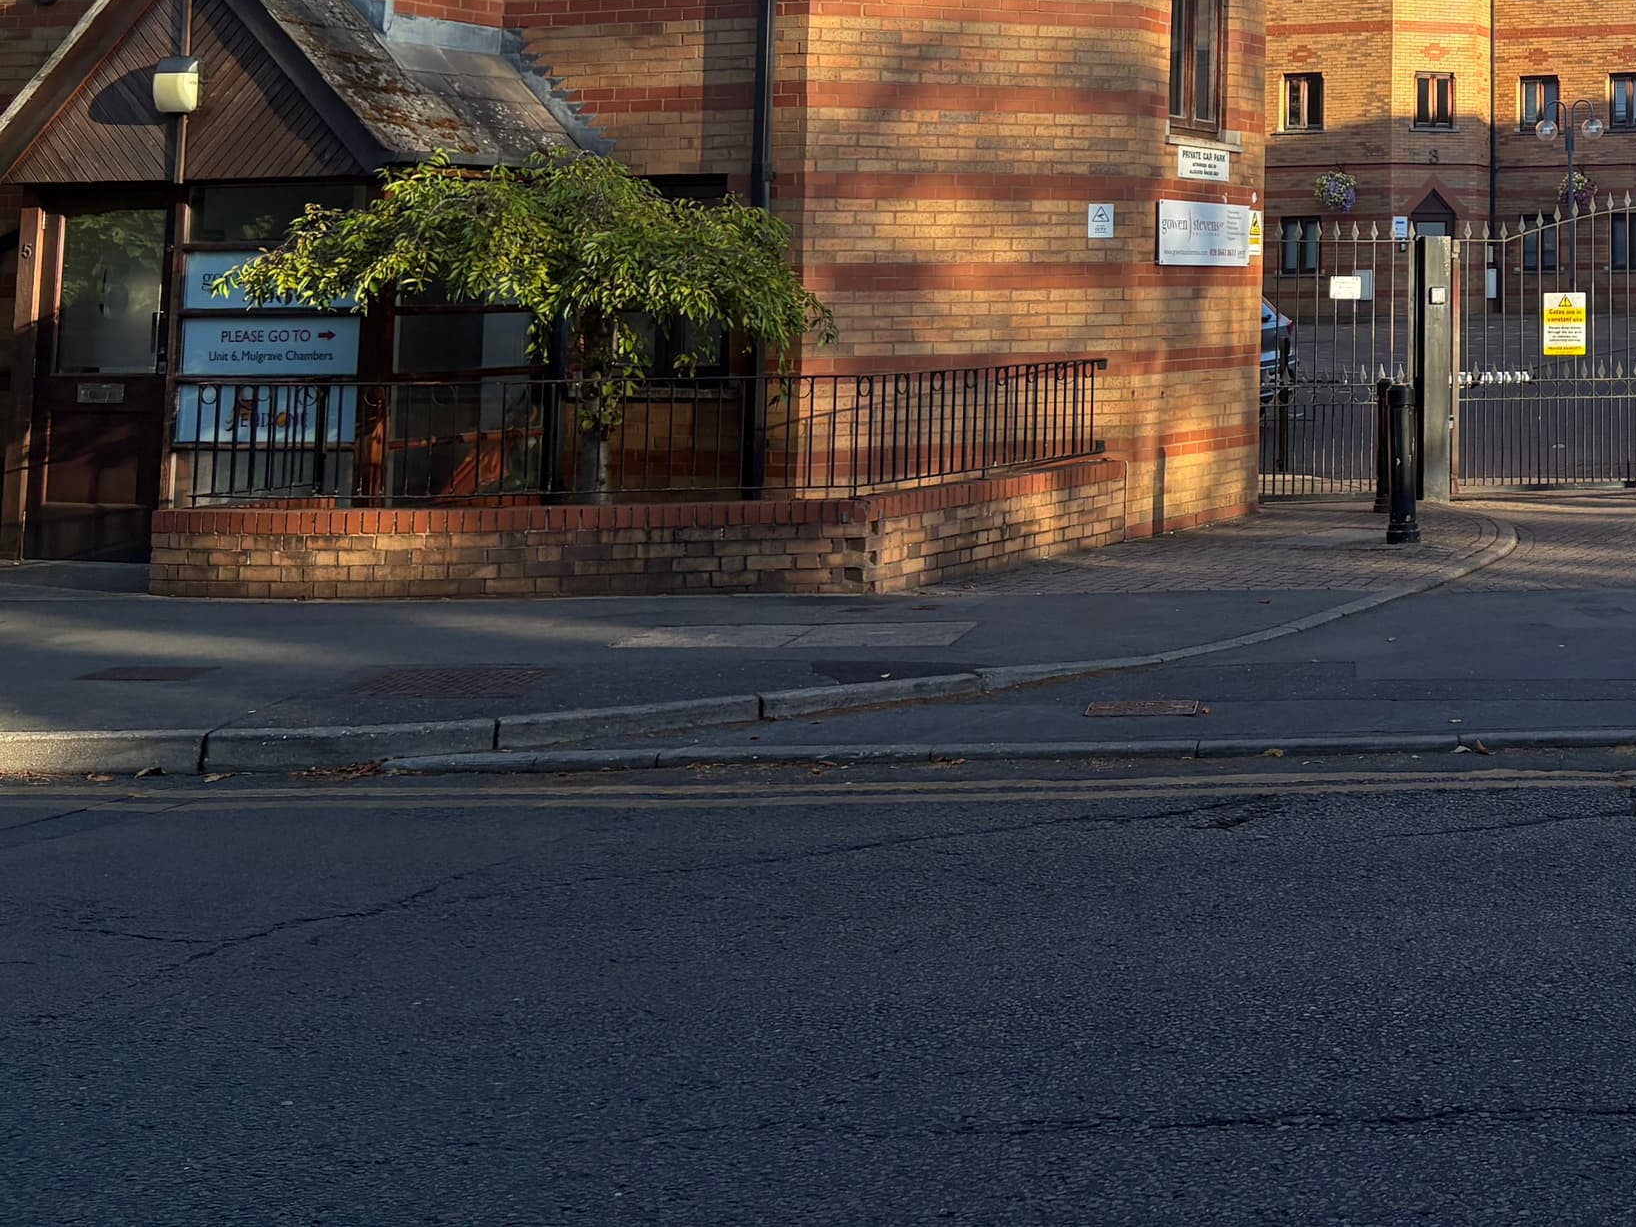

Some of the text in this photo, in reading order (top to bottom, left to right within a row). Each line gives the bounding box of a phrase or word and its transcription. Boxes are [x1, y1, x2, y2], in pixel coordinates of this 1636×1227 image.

[1182, 150, 1226, 162] PRIVATE CAR PARK
[1429, 149, 1439, 163] 3
[1161, 218, 1188, 234] gowen
[1193, 218, 1220, 232] stevens
[22, 243, 33, 259] 5
[221, 328, 311, 343] PLEASE GO TO
[209, 350, 334, 364] Unit 6, Mulgrave Chambers
